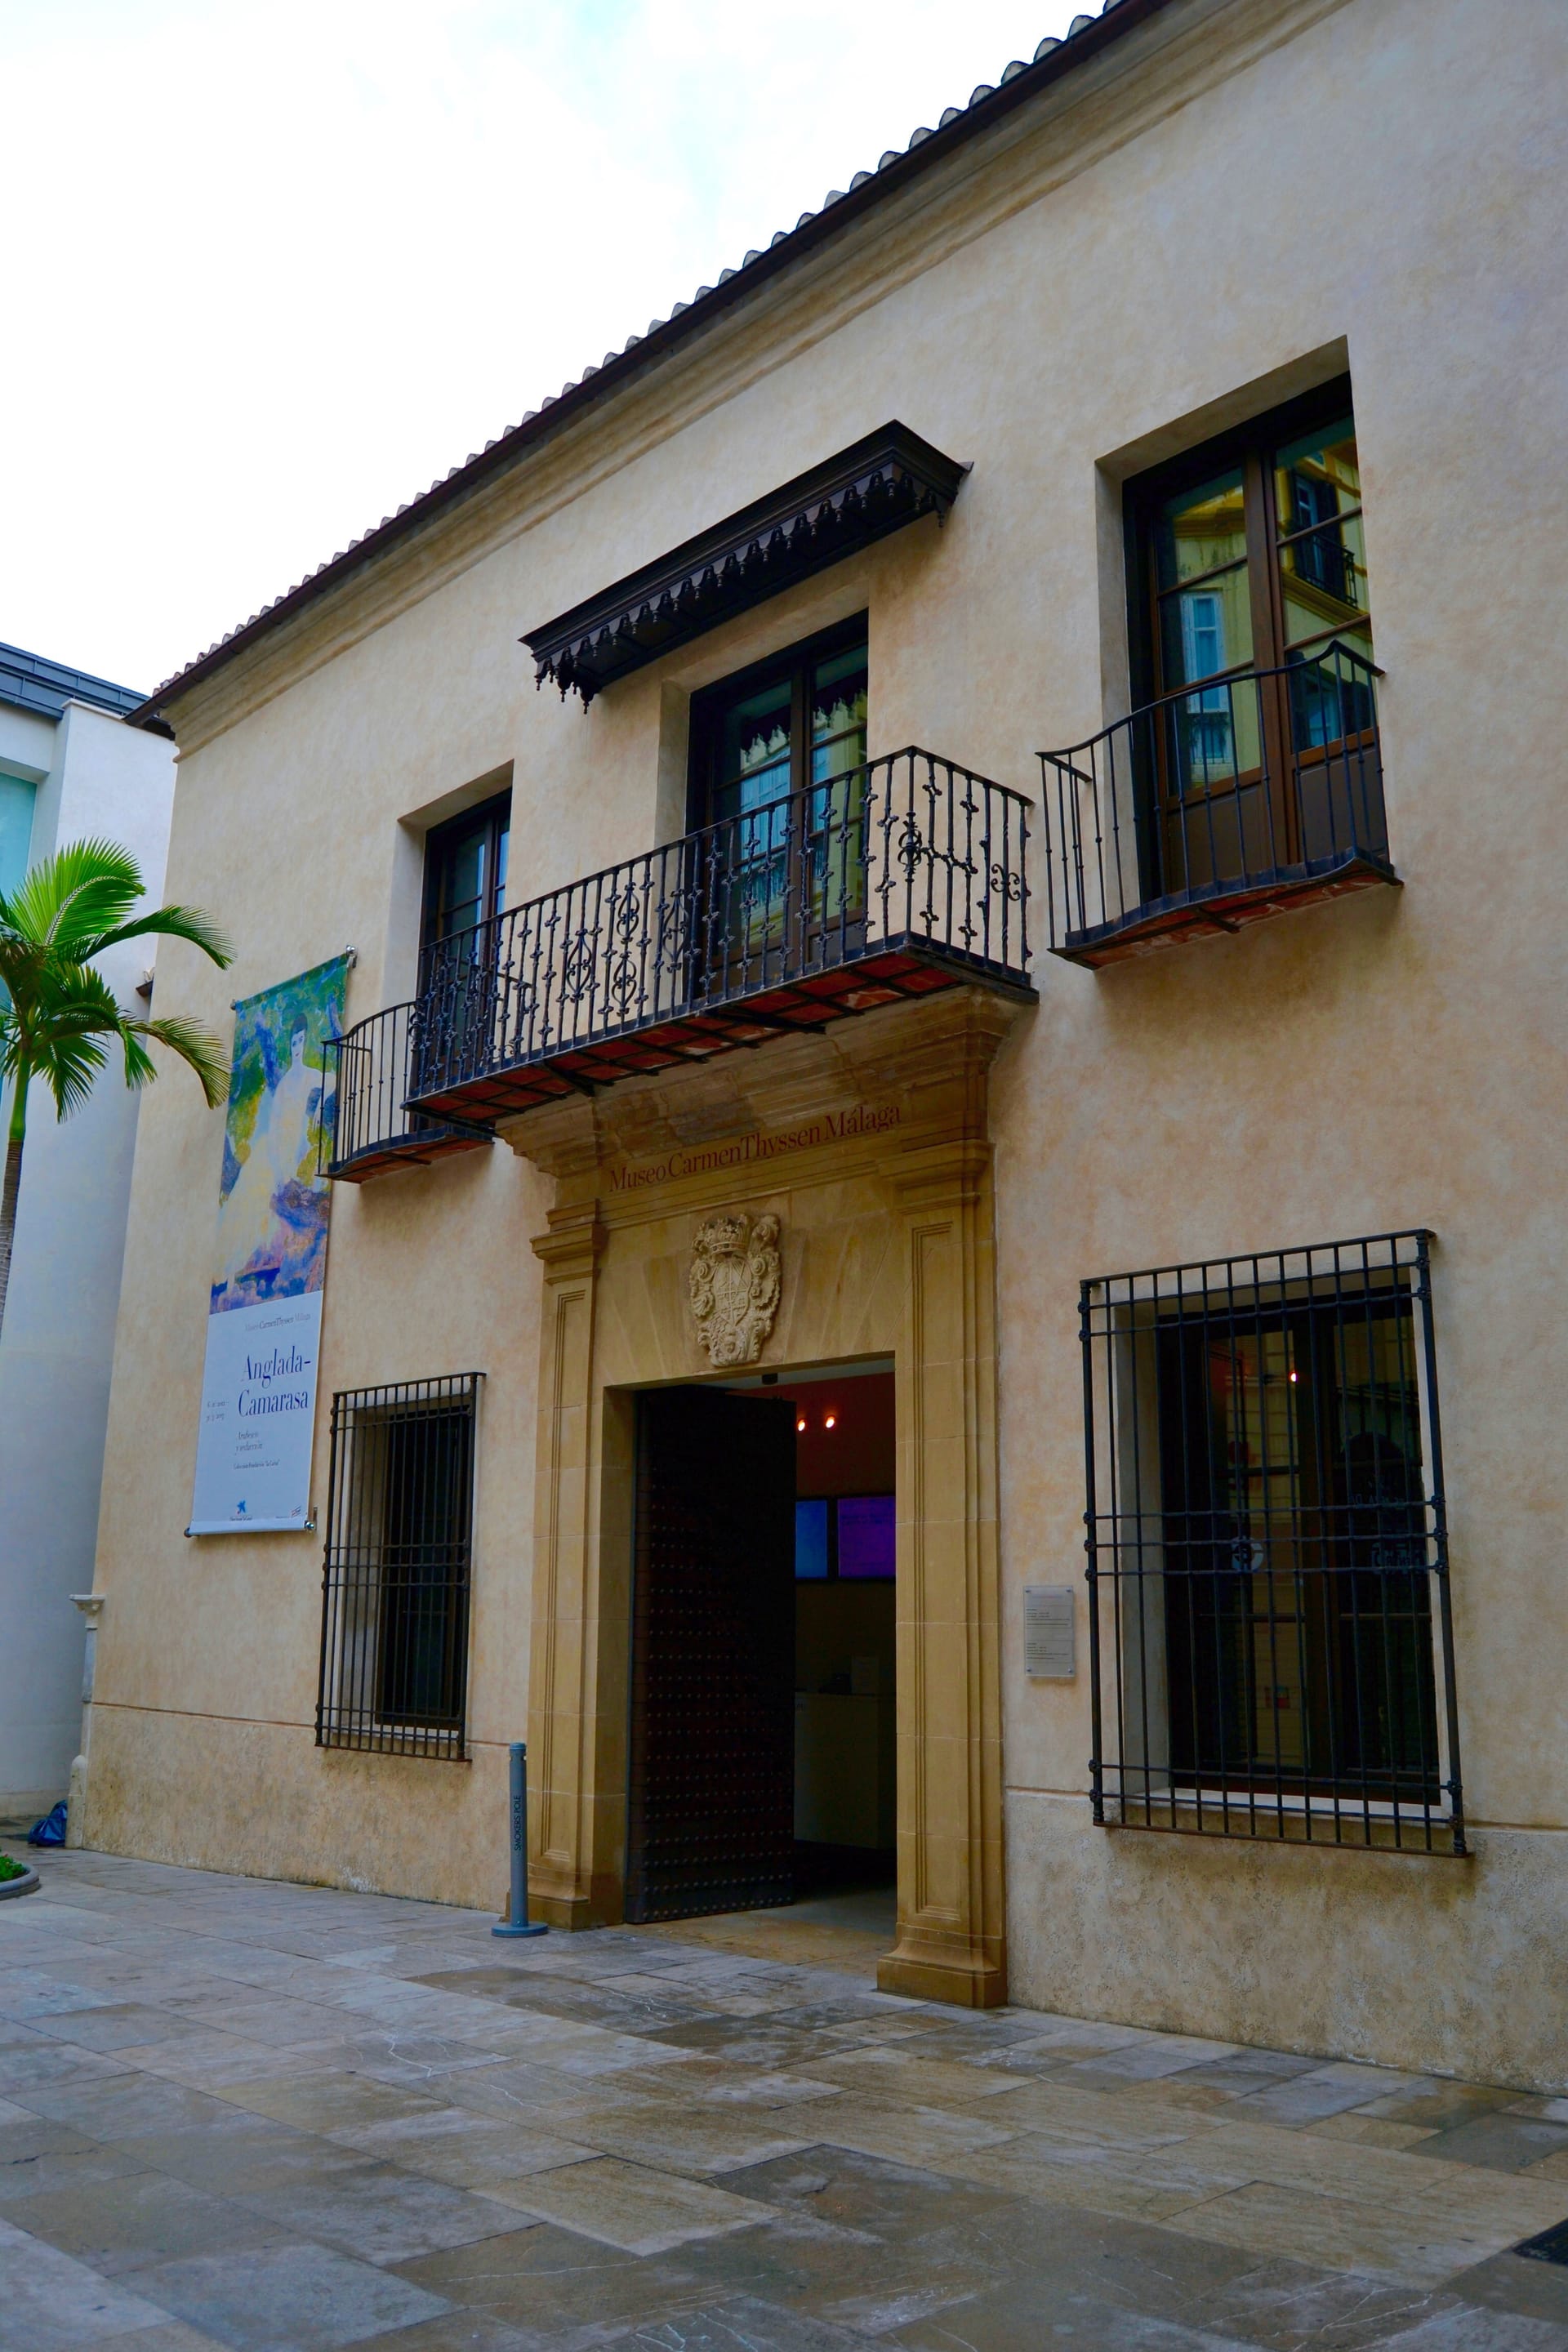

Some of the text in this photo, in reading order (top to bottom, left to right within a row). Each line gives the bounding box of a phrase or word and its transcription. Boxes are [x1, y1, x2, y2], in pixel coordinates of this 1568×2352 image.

[608, 1105, 902, 1192] Museo Carmen Thyssen Málaga
[241, 1345, 311, 1389] Anglada-
[238, 1388, 308, 1418] Camarasa
[514, 1815, 522, 1851] SMOKERS
